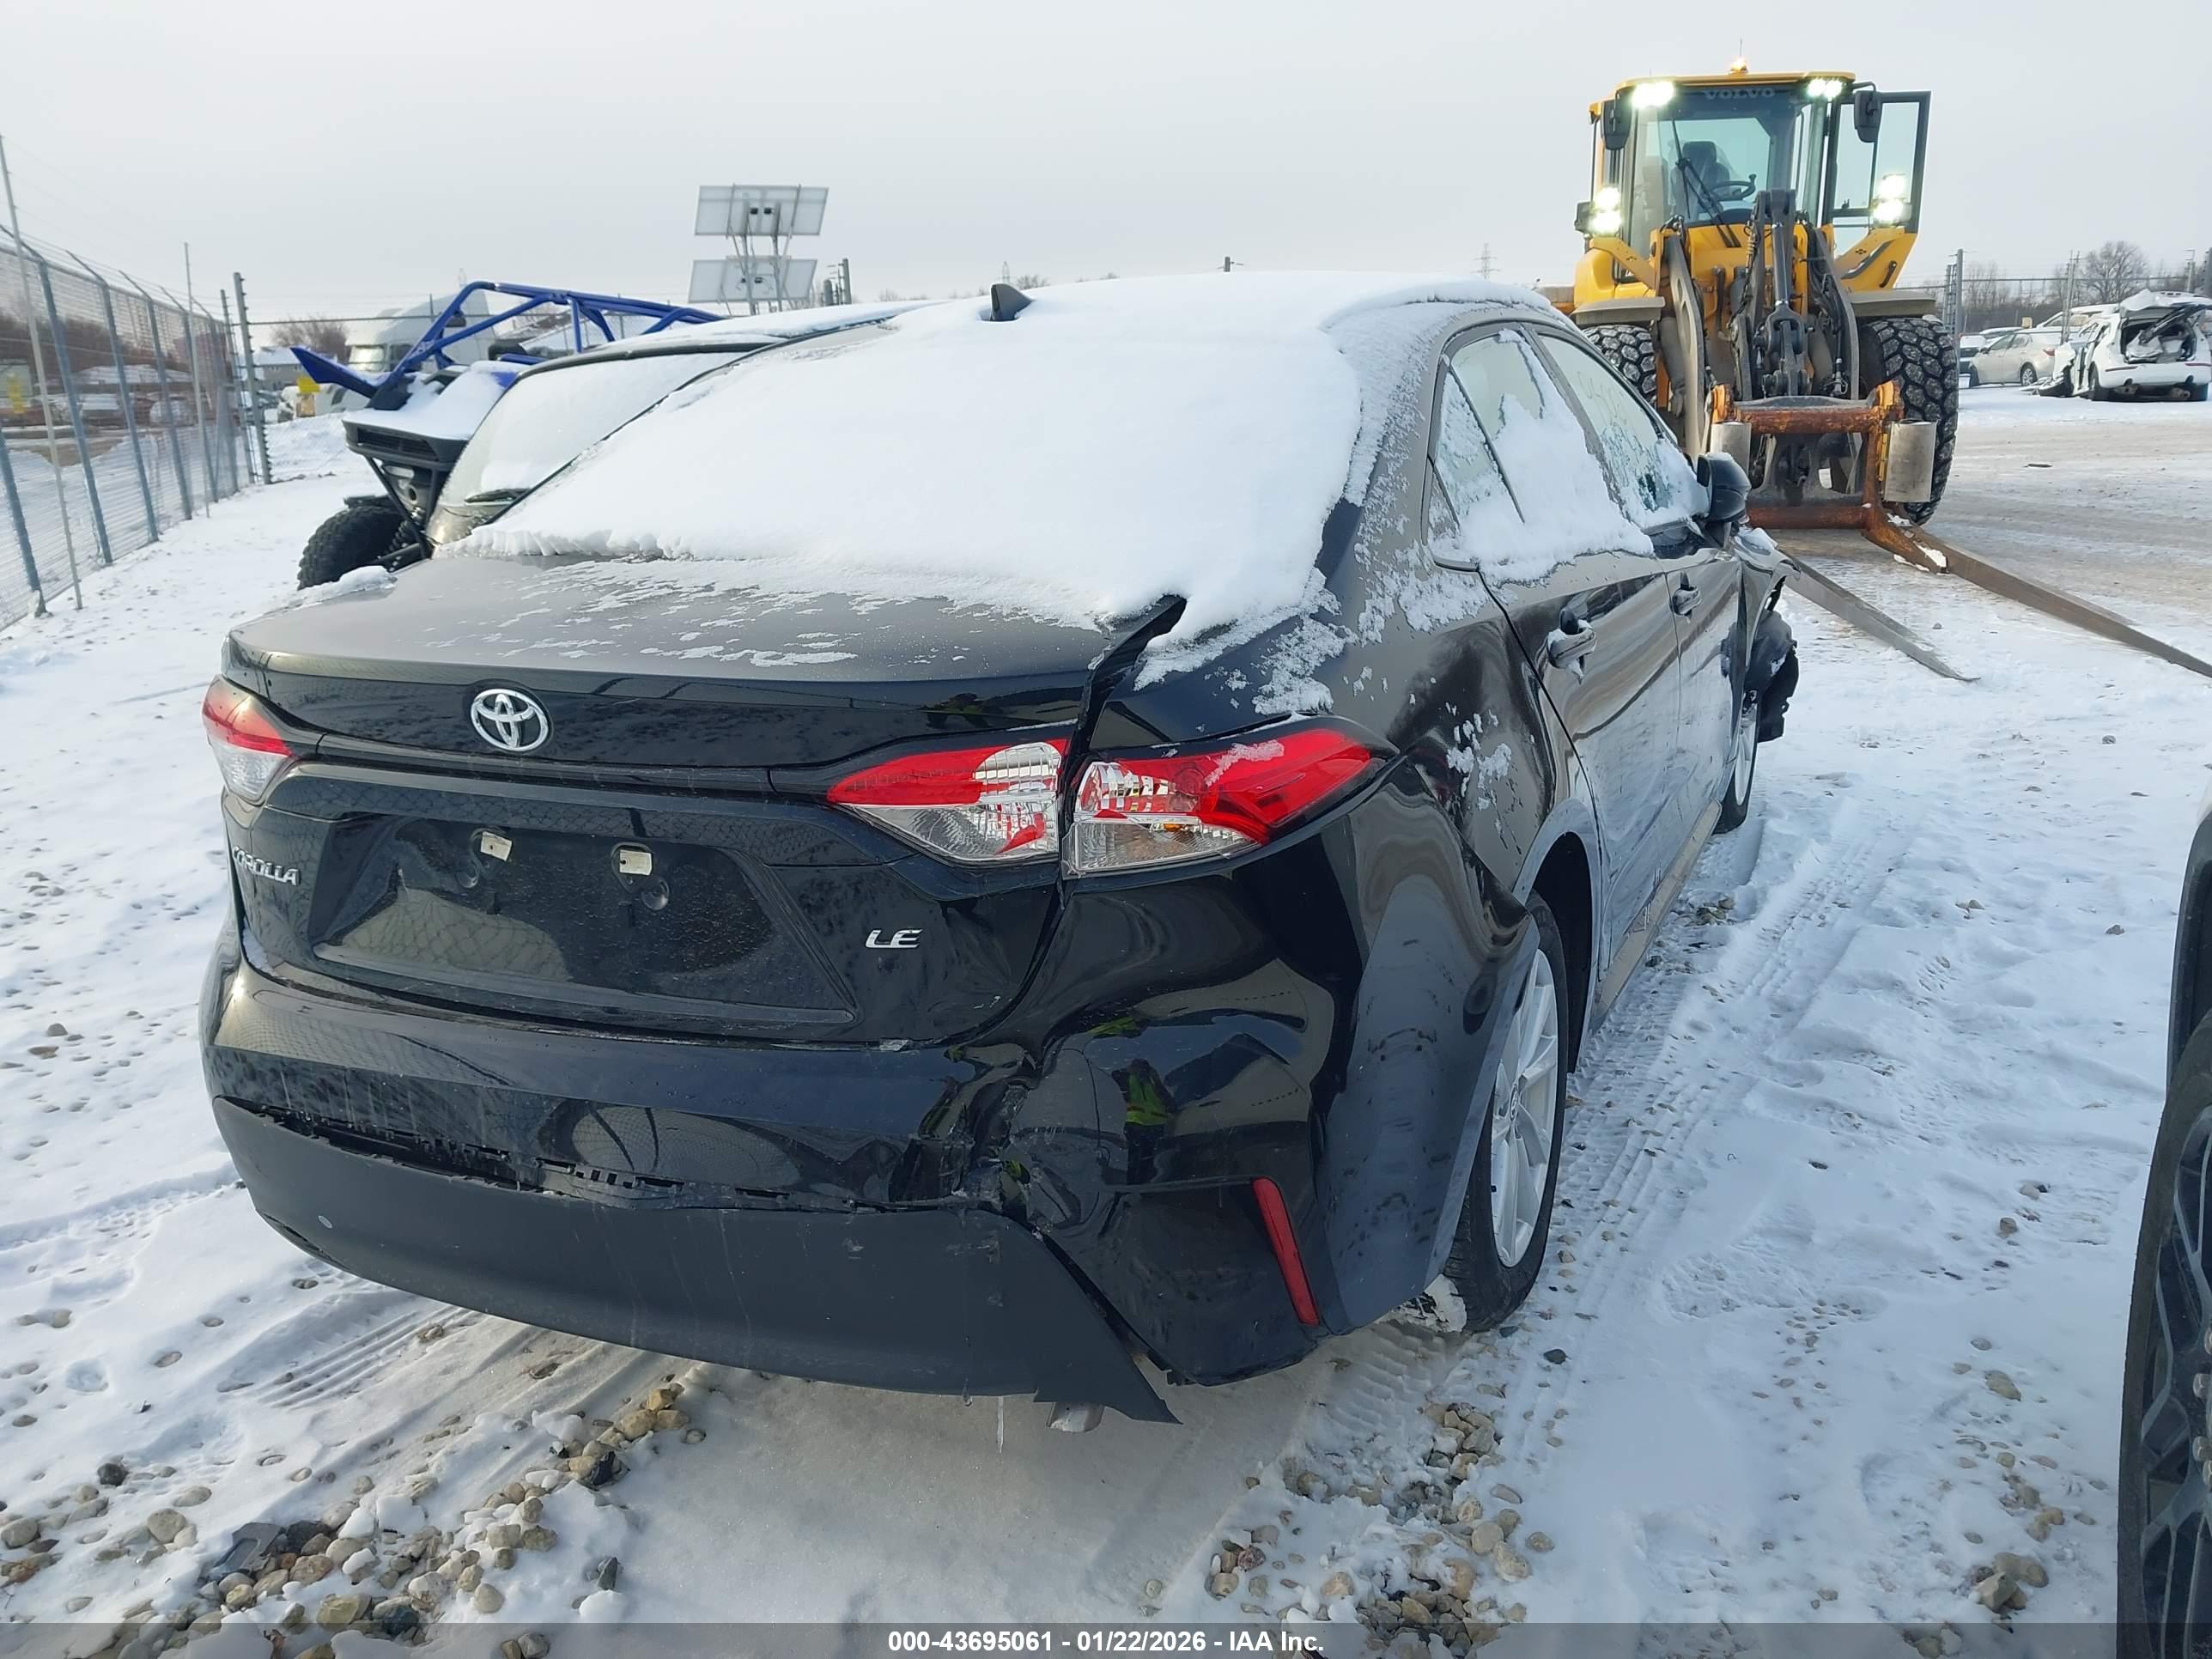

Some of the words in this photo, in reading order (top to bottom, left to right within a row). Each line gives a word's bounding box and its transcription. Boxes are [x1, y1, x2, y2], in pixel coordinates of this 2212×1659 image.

[1704, 88, 1775, 100] VOLVO
[233, 846, 299, 885] COROLLA
[866, 929, 922, 948] LE
